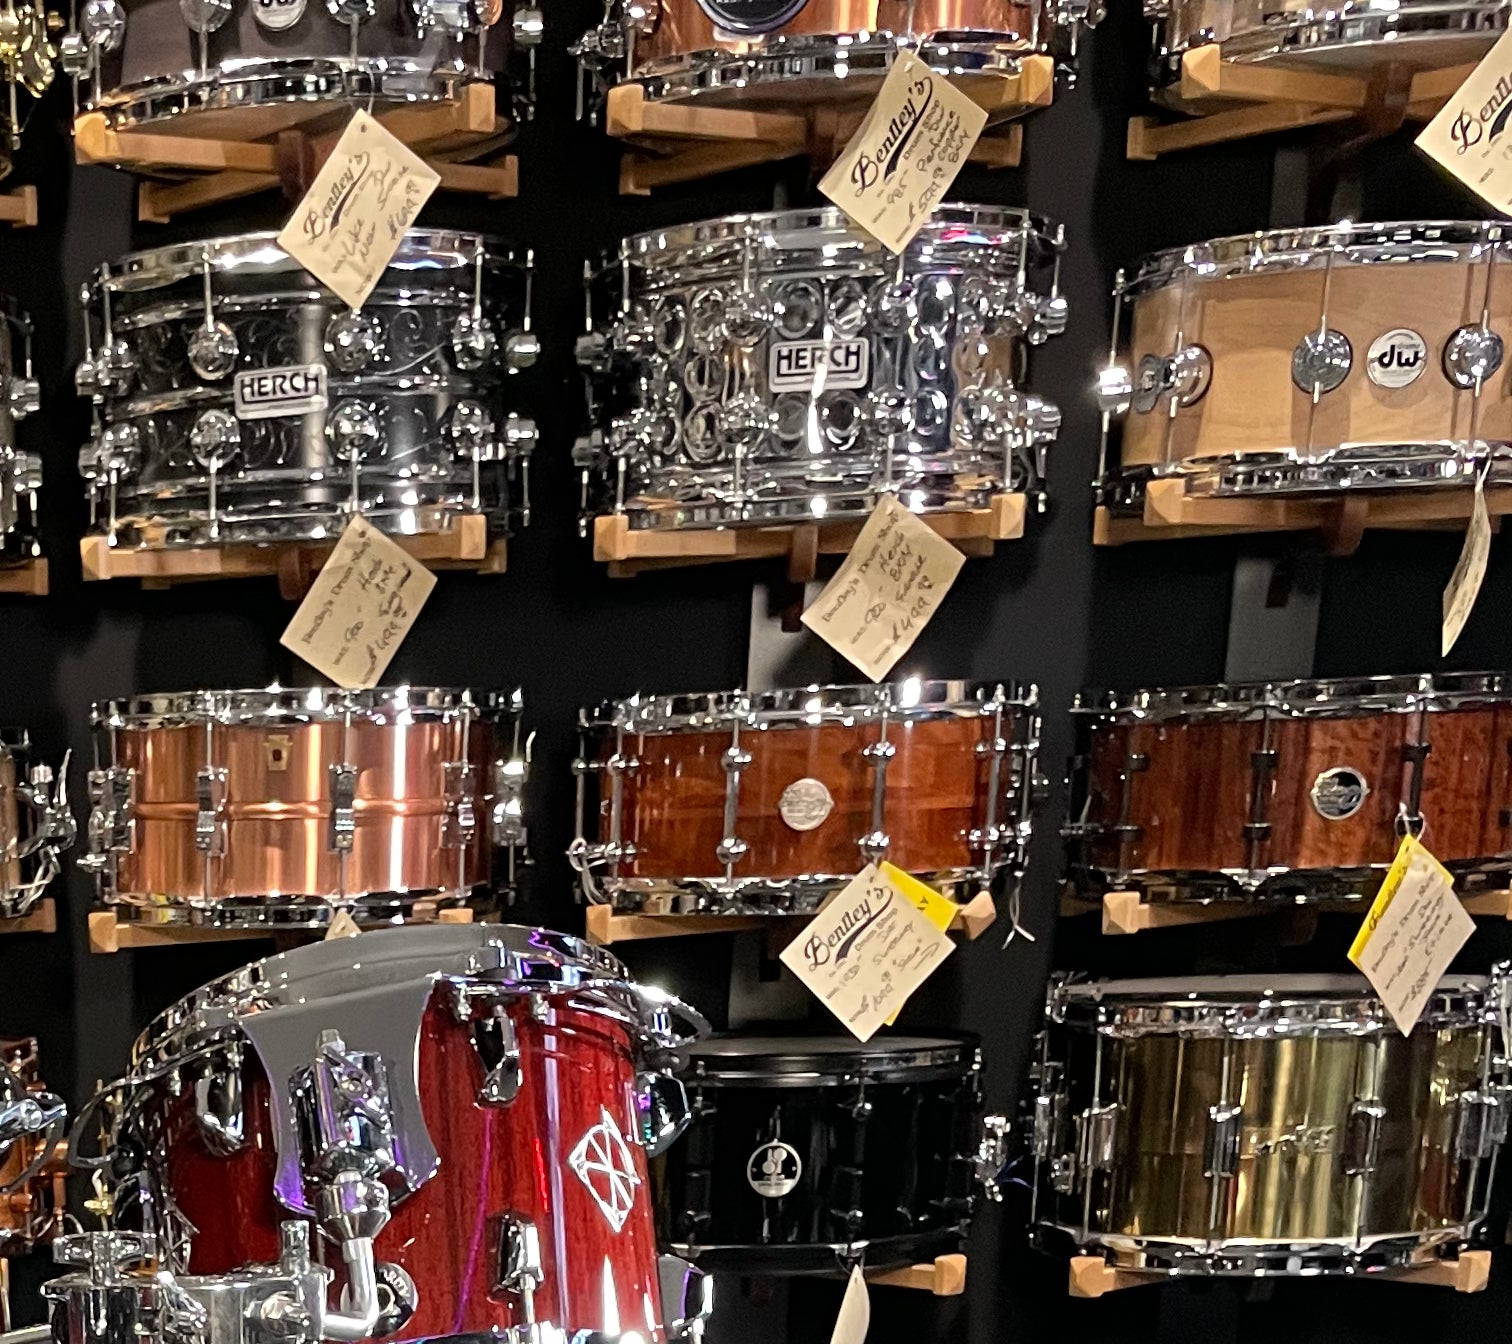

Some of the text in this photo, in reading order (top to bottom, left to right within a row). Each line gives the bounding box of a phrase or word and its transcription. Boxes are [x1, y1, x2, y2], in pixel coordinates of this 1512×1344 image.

[851, 79, 925, 197] Bentley's
[1450, 70, 1512, 155] Bentl
[303, 153, 365, 244] Bentley's
[240, 372, 319, 401] HERCH
[777, 345, 861, 375] HERCH
[1378, 345, 1419, 369] dw
[804, 885, 885, 972] Bentley's
